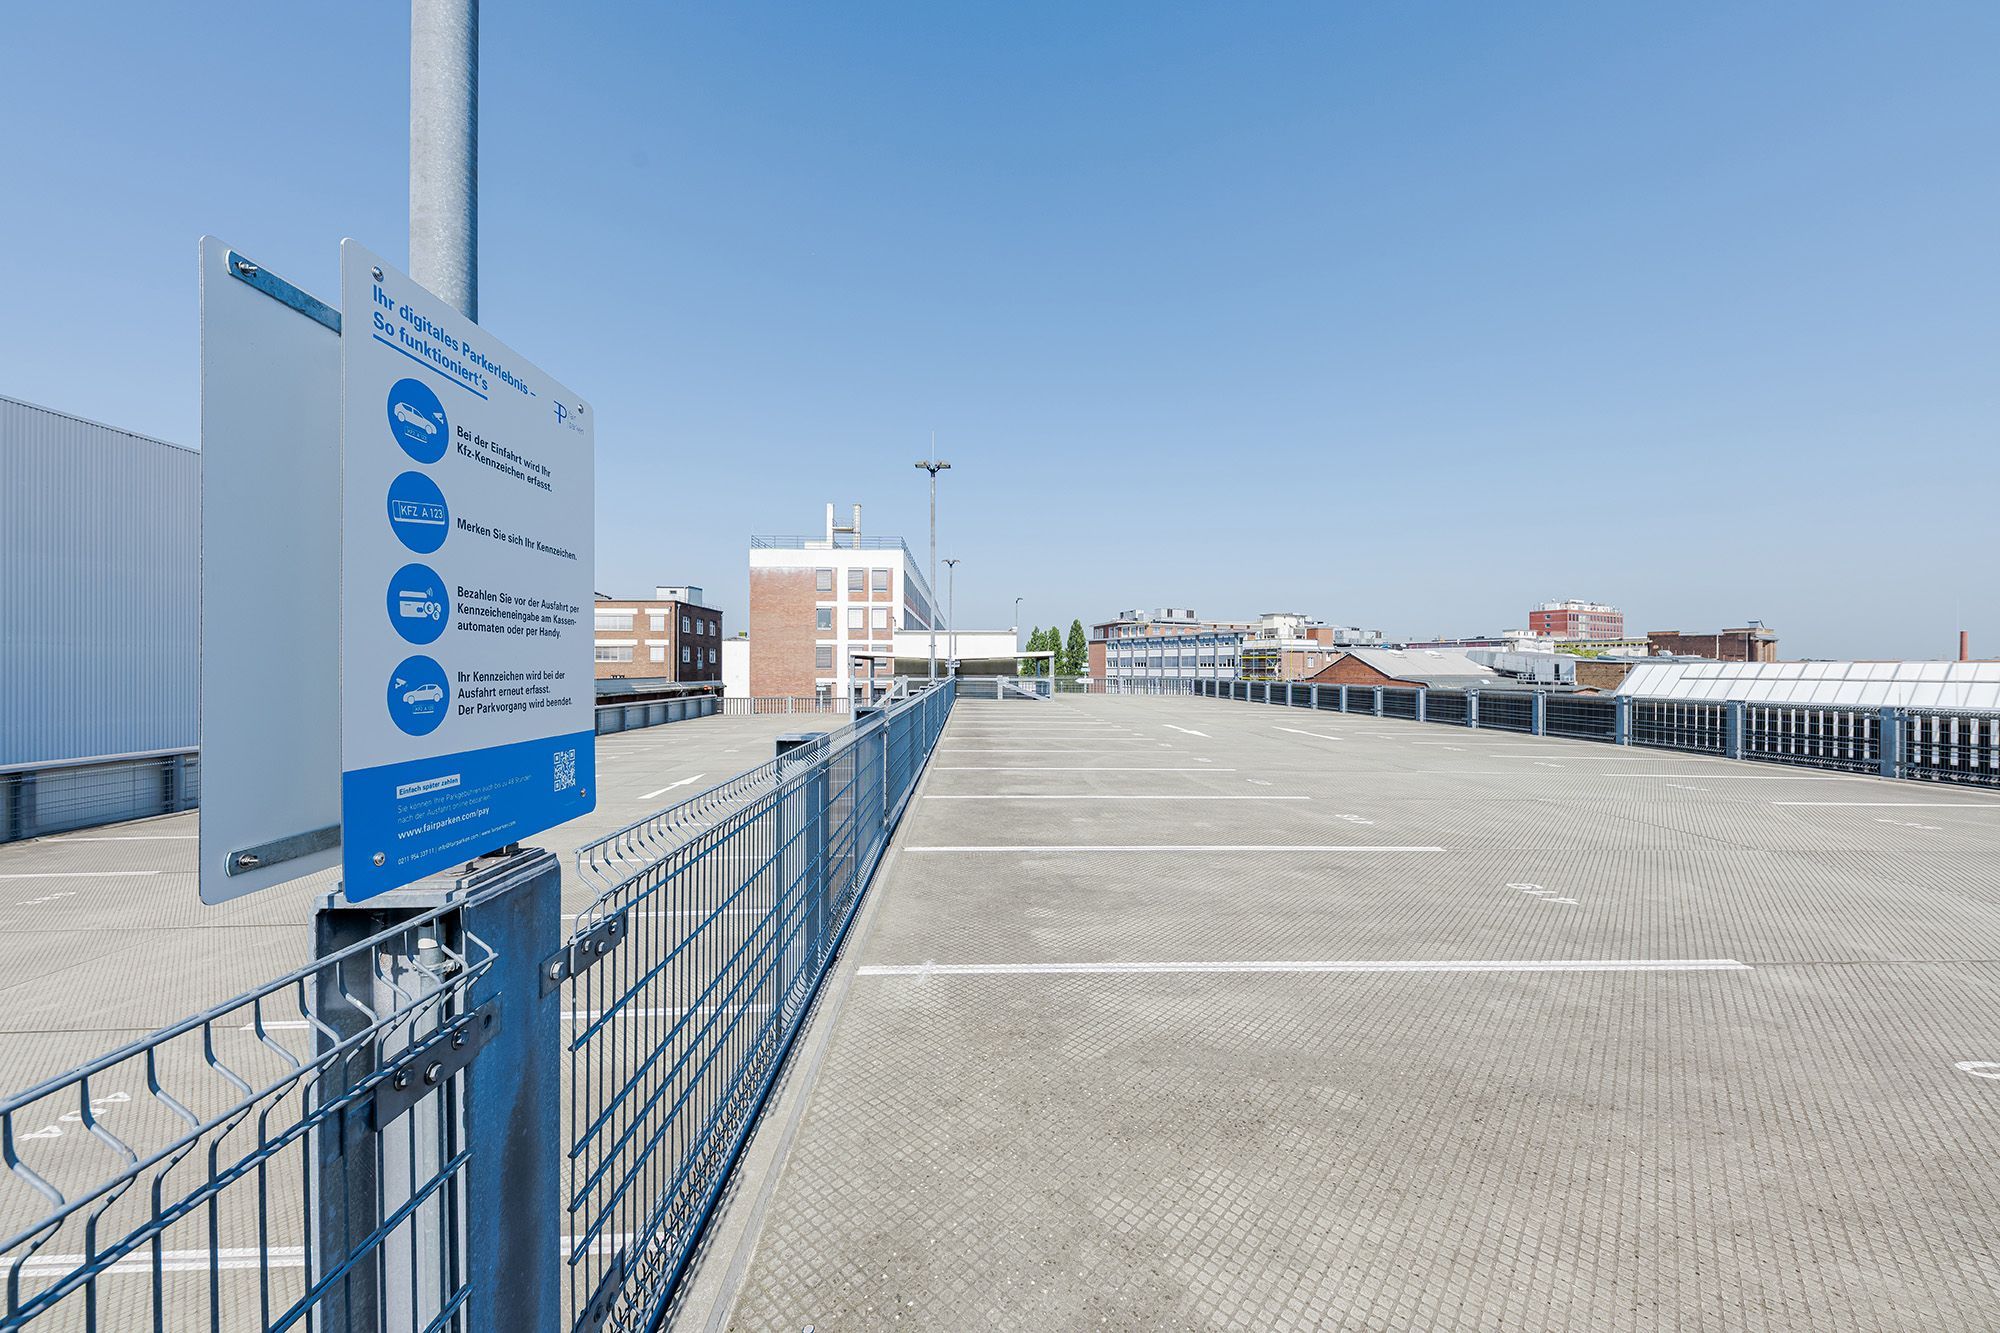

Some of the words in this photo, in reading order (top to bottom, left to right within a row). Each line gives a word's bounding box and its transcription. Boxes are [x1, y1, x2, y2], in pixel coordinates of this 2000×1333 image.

[373, 311, 395, 336] So
[373, 284, 395, 311] Ihr
[400, 304, 459, 351] digitales
[462, 341, 528, 395] Parkerlebnis
[457, 425, 472, 442] Bei
[474, 434, 489, 449] der
[490, 441, 522, 465] Einfahrt
[524, 459, 540, 473] wird
[541, 464, 551, 478] Ihr
[457, 442, 525, 480] Kfz-Kennzeichen
[527, 475, 553, 492] erfasst.
[400, 505, 418, 517] KFZ
[421, 507, 428, 518] A
[430, 508, 443, 519] 123
[457, 517, 491, 537] Merken
[493, 528, 506, 541] Sie
[508, 533, 523, 546] sich
[525, 537, 535, 549] Ihr
[536, 541, 578, 560] Kennzeichen.
[457, 586, 497, 602] Bezahlen
[499, 593, 512, 604] Sie
[514, 597, 526, 606] vor
[528, 599, 540, 608] der
[541, 600, 569, 613] Ausfahrt
[570, 605, 580, 614] per
[457, 603, 540, 623] Kennzeicheneingabe
[541, 615, 552, 623] am
[553, 614, 577, 626] Kassen-
[457, 620, 505, 634] automaten
[507, 625, 524, 635] oder
[525, 628, 538, 637] per
[539, 627, 561, 639] Handy.
[457, 671, 470, 683] Ihr
[473, 670, 524, 682] Kennzeichen
[525, 670, 542, 681] wird
[543, 670, 553, 680] bei
[554, 671, 565, 680] der
[458, 687, 496, 699] Ausfahrt
[498, 687, 524, 697] erneut
[525, 685, 550, 695] erfasst.
[458, 705, 474, 716] Der
[477, 702, 527, 715] Parkvorgang
[529, 699, 545, 709] wird
[546, 697, 573, 707] beendet.
[399, 785, 422, 796] Einfach
[441, 777, 459, 787] zahlen
[397, 807, 490, 840] www.fairparken.com/pay
